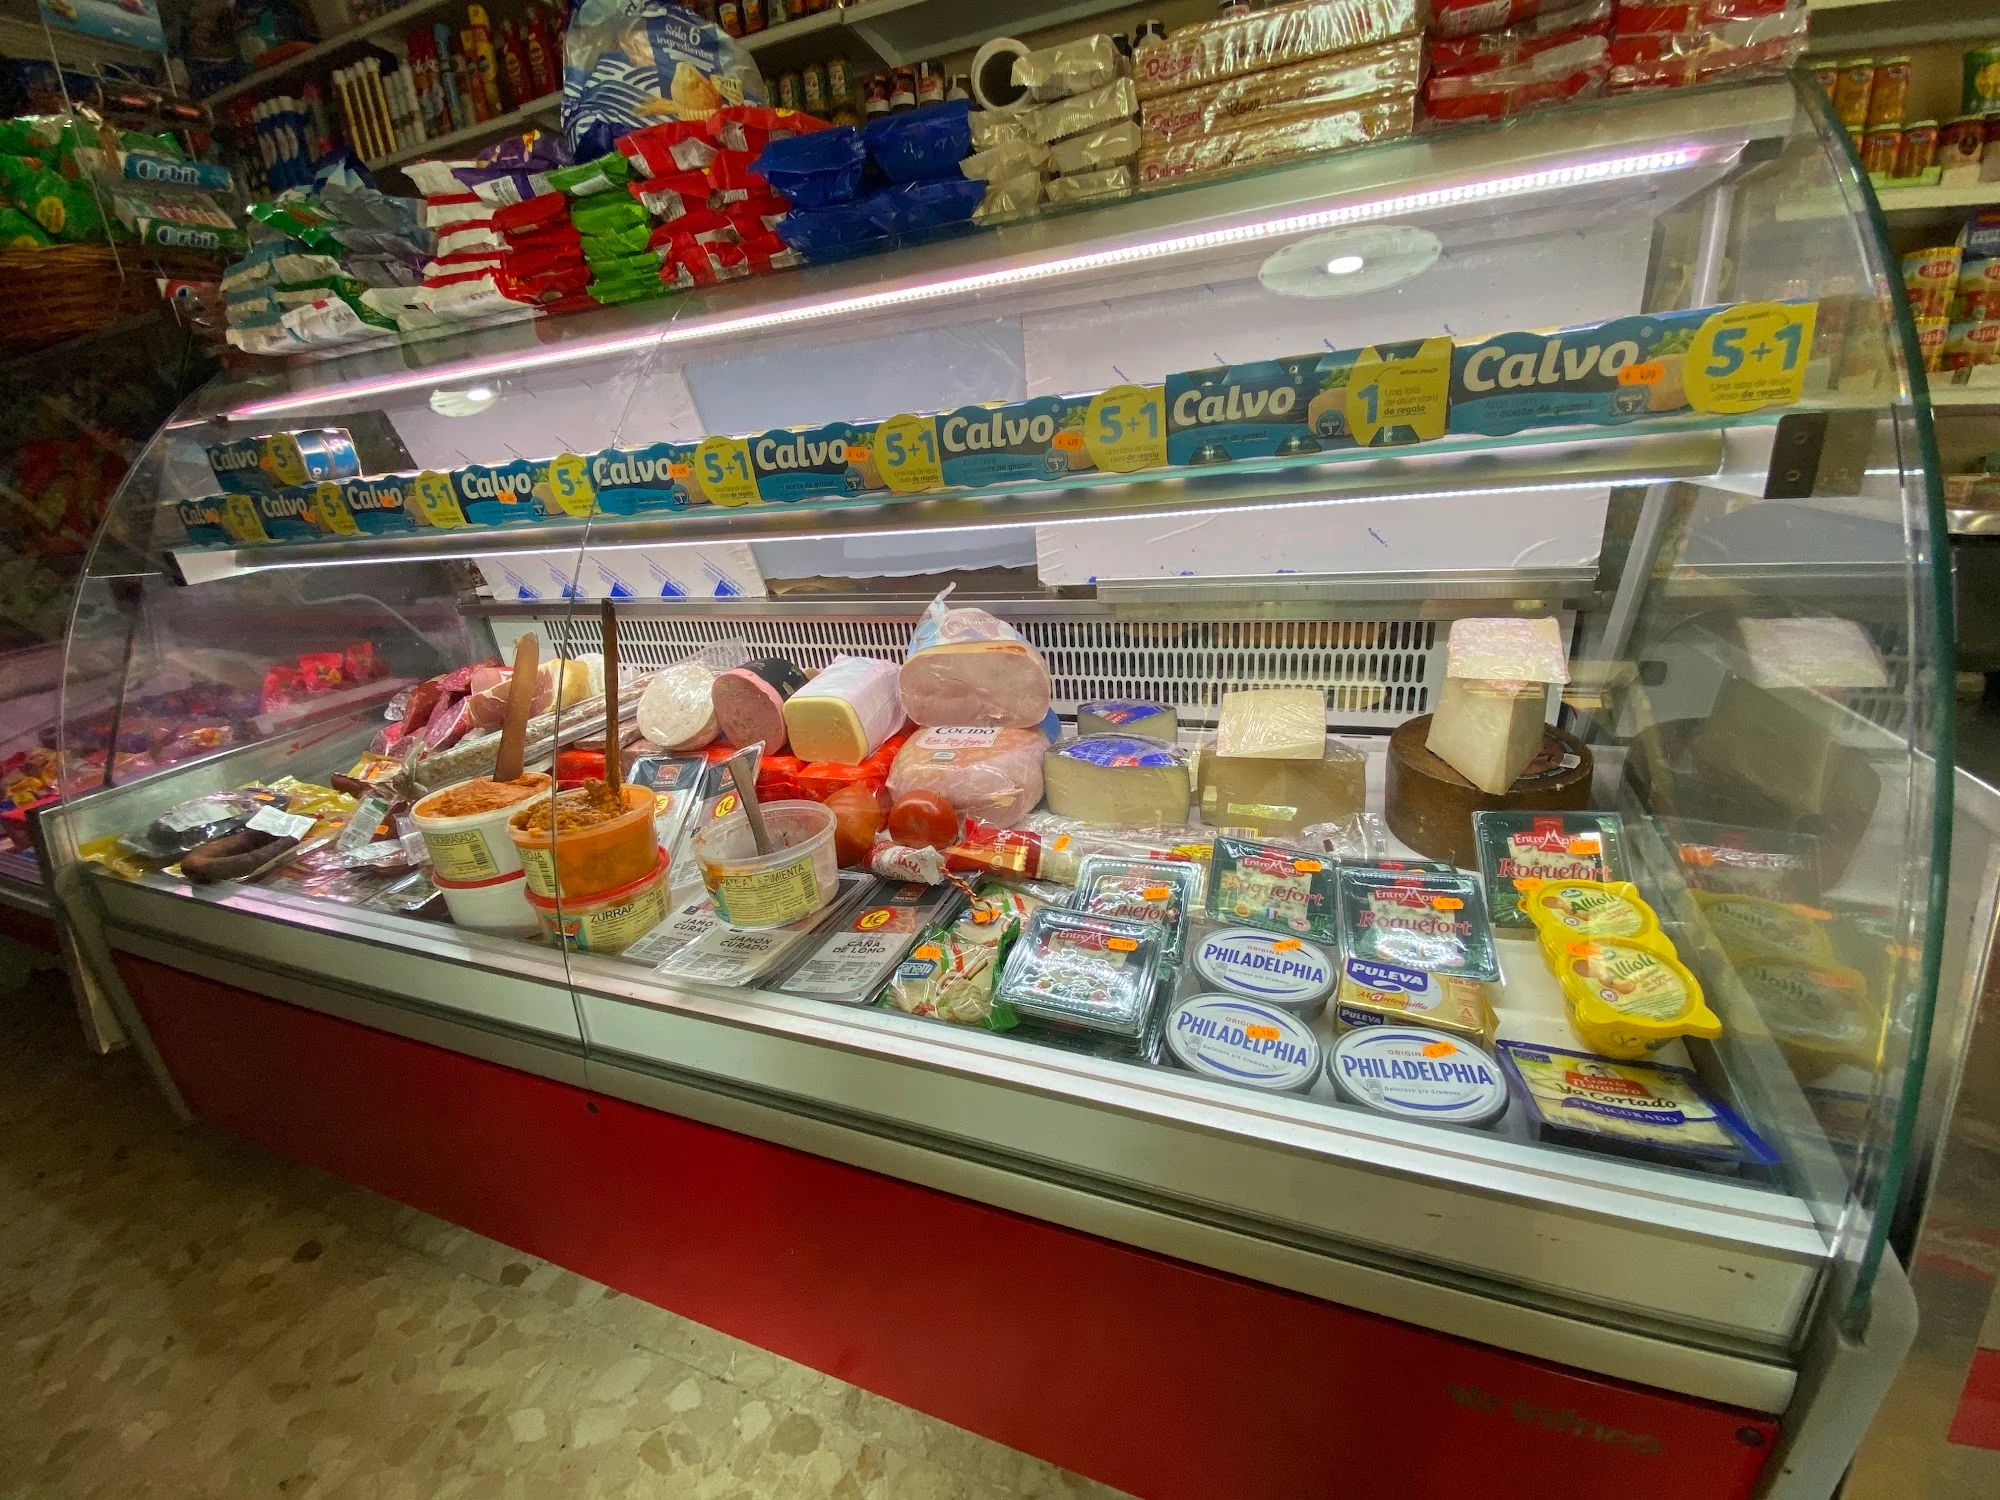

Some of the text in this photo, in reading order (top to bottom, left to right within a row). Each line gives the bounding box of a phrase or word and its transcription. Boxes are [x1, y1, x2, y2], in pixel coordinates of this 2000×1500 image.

[689, 24, 701, 46] 6
[137, 159, 200, 185] Orbit
[1705, 322, 1803, 378] 5+1
[1463, 339, 1640, 392] Calvo
[1173, 385, 1296, 427] Calvo
[1357, 383, 1379, 424] 1
[1397, 404, 1426, 415] regalo
[942, 413, 1054, 453] Calvo
[1099, 401, 1159, 444] 5+1
[210, 447, 259, 472] Calvo
[756, 436, 848, 472] Calvo
[885, 429, 936, 467] 5+1
[593, 456, 674, 487] Calvo
[704, 451, 749, 485] 5+1
[347, 484, 403, 510] Calvo
[461, 470, 531, 500] Calvo
[261, 495, 308, 518] Calvo
[719, 796, 735, 814] 1€
[1497, 858, 1613, 881] Roquefort
[865, 912, 889, 925] 1€
[1358, 910, 1473, 936] Roquefort
[719, 941, 769, 951] CURADO
[730, 935, 773, 945] JAMÓN
[846, 938, 882, 948] CAÑA
[1247, 945, 1287, 957] ORIGINAL
[1204, 943, 1324, 984] PHILADELPHIA
[1352, 962, 1424, 987] PULEVA
[1341, 1008, 1382, 1025] PULEVA
[1177, 1011, 1308, 1067] PHILADELPHIA
[1341, 1054, 1495, 1086] PHILADELPHIA
[1555, 1083, 1677, 1109] Ya Cortado
[1571, 1099, 1678, 1124] SEMICURADO
